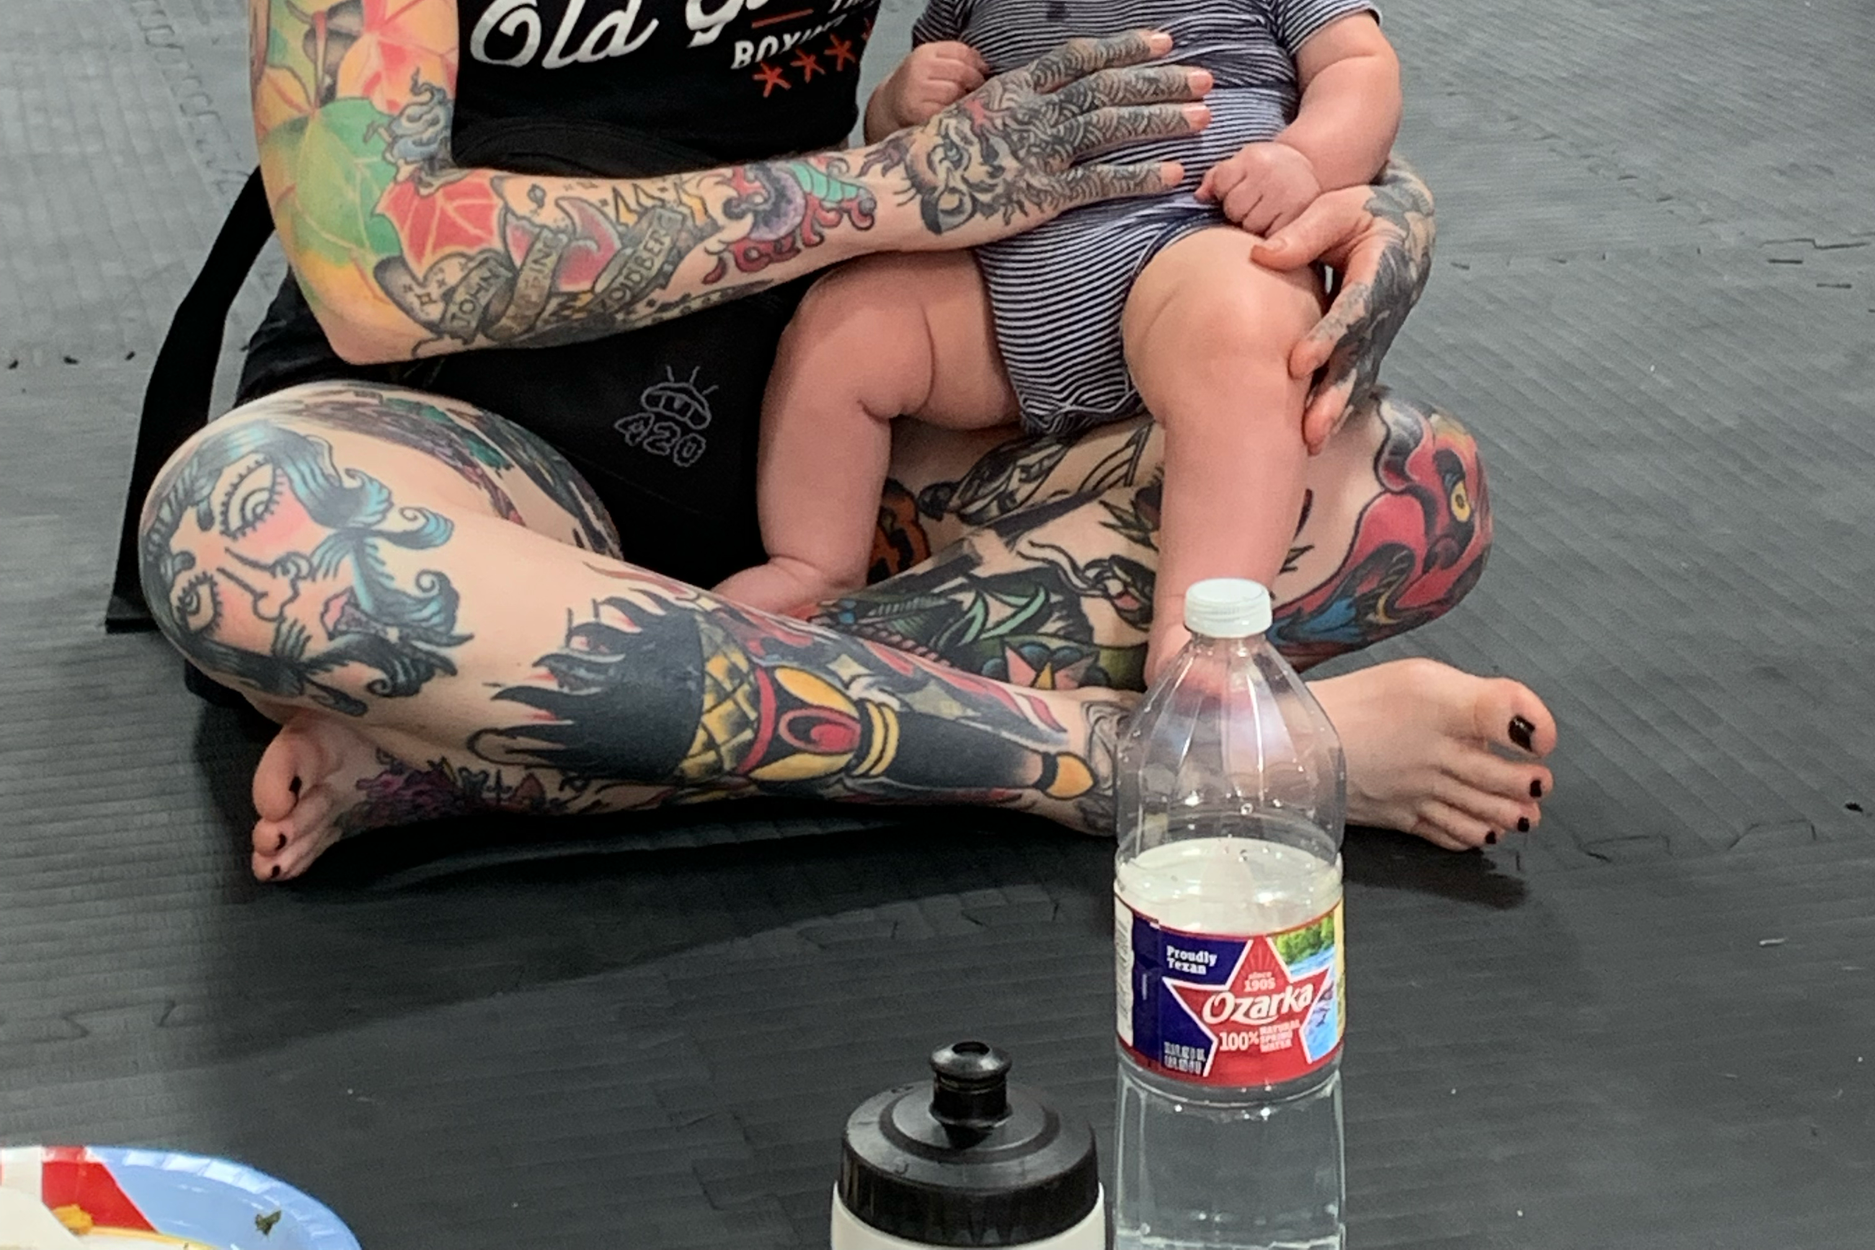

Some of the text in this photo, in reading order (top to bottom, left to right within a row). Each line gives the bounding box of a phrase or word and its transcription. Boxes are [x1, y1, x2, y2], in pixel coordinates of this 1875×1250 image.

[452, 264, 502, 329] JOHN
[614, 412, 707, 468] 420
[1166, 945, 1218, 967] Proudly
[1166, 957, 1207, 975] Texan
[1202, 983, 1314, 1026] Ozarka
[1219, 1030, 1260, 1051] 100%
